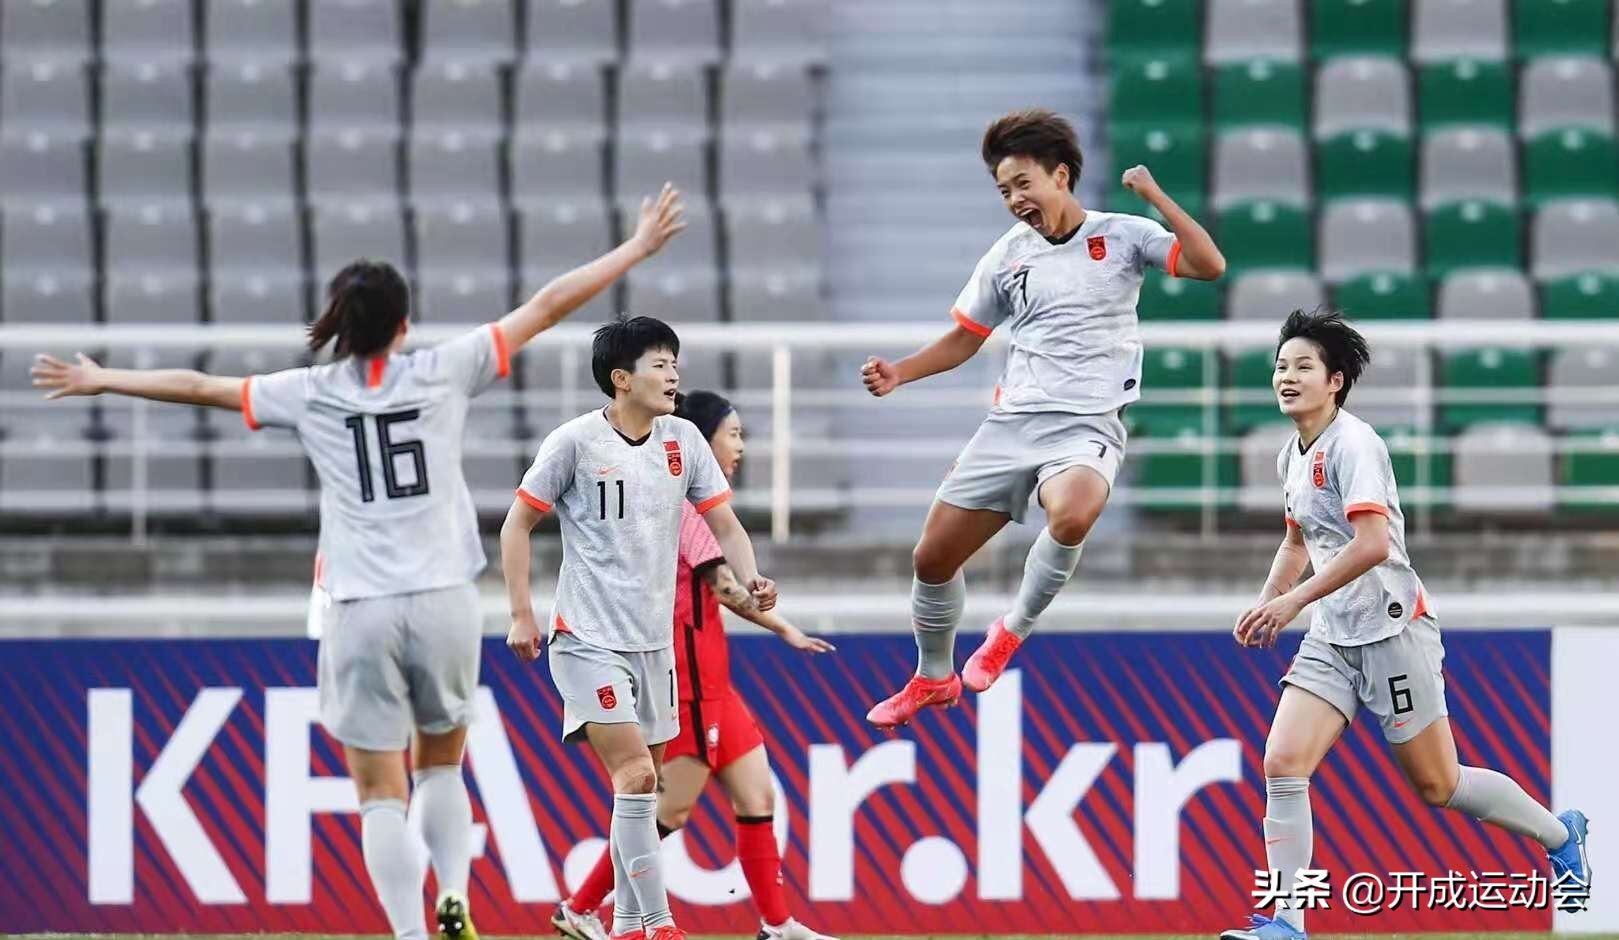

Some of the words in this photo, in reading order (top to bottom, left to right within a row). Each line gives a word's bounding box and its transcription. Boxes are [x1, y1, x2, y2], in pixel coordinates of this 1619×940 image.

[1013, 269, 1029, 308] 7
[345, 409, 429, 502] 16
[597, 480, 624, 520] 11
[1388, 674, 1414, 715] 6
